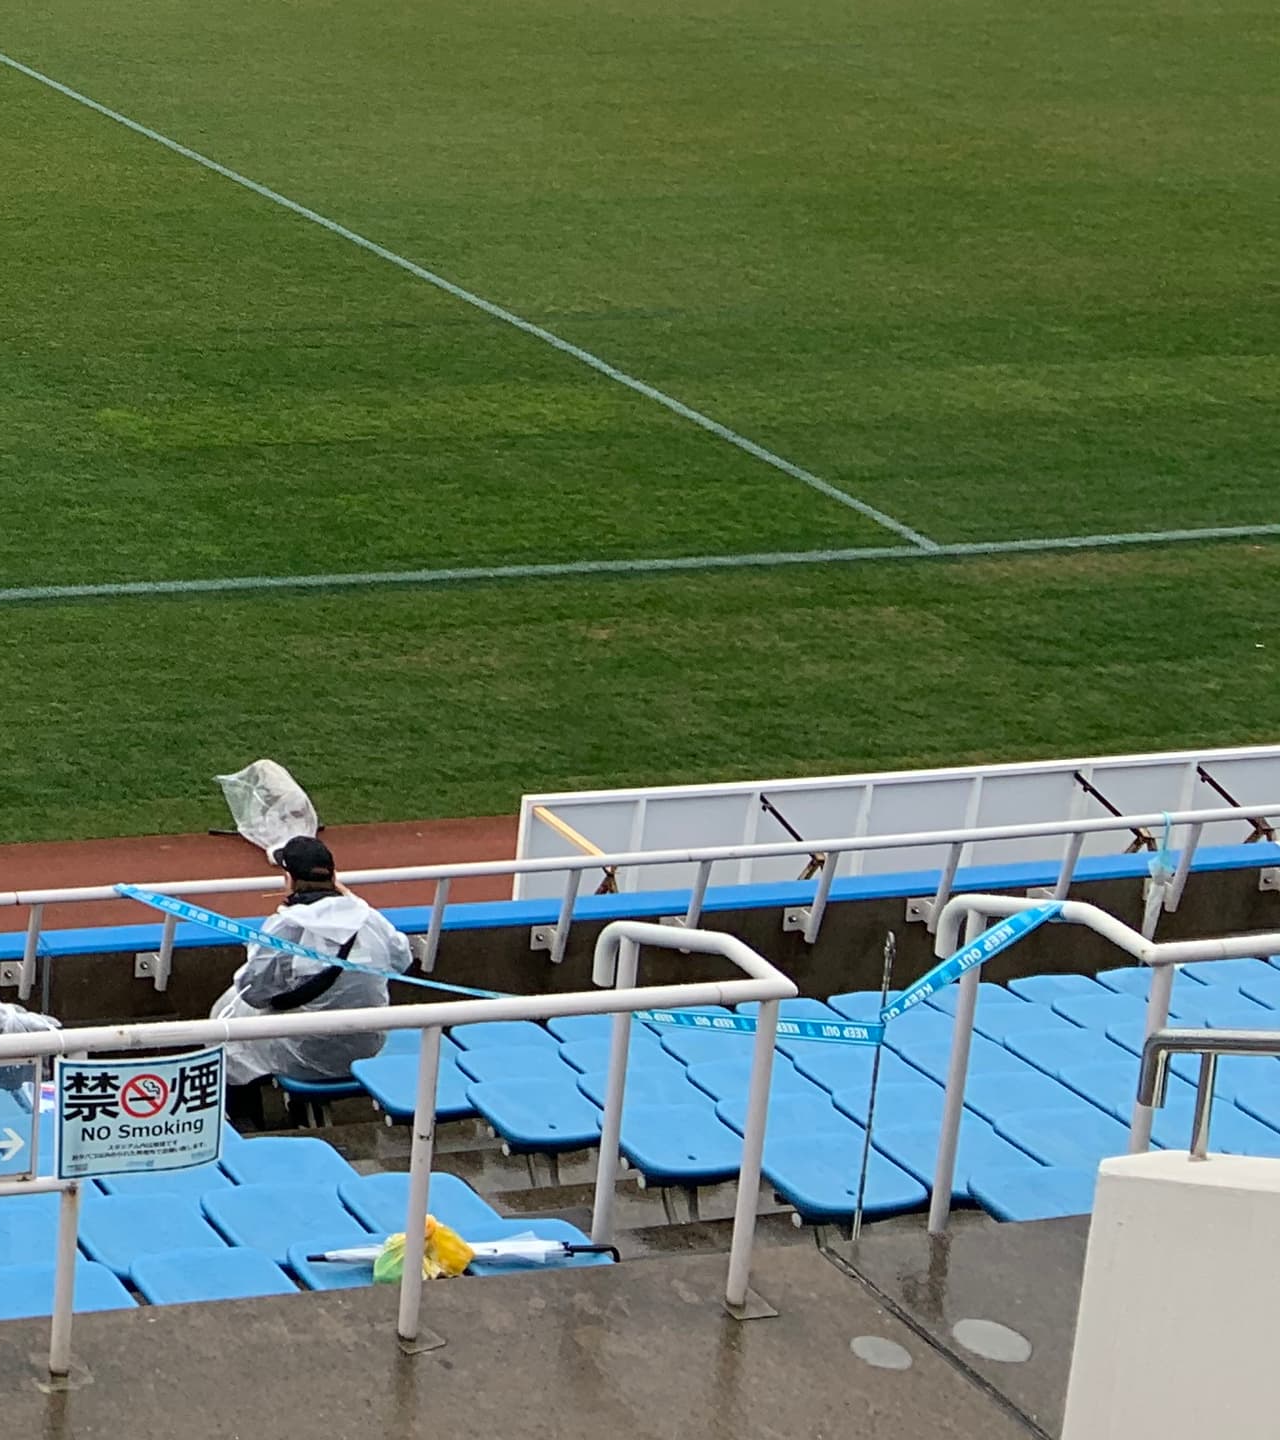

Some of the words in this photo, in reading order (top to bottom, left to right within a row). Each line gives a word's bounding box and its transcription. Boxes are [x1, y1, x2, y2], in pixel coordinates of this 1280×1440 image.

[983, 924, 1016, 952] KEEP
[957, 948, 983, 971] OUT
[821, 1024, 841, 1037] OUT
[843, 1026, 870, 1040] KEEP
[81, 1126, 111, 1142] NO
[118, 1118, 204, 1140] Smoking
